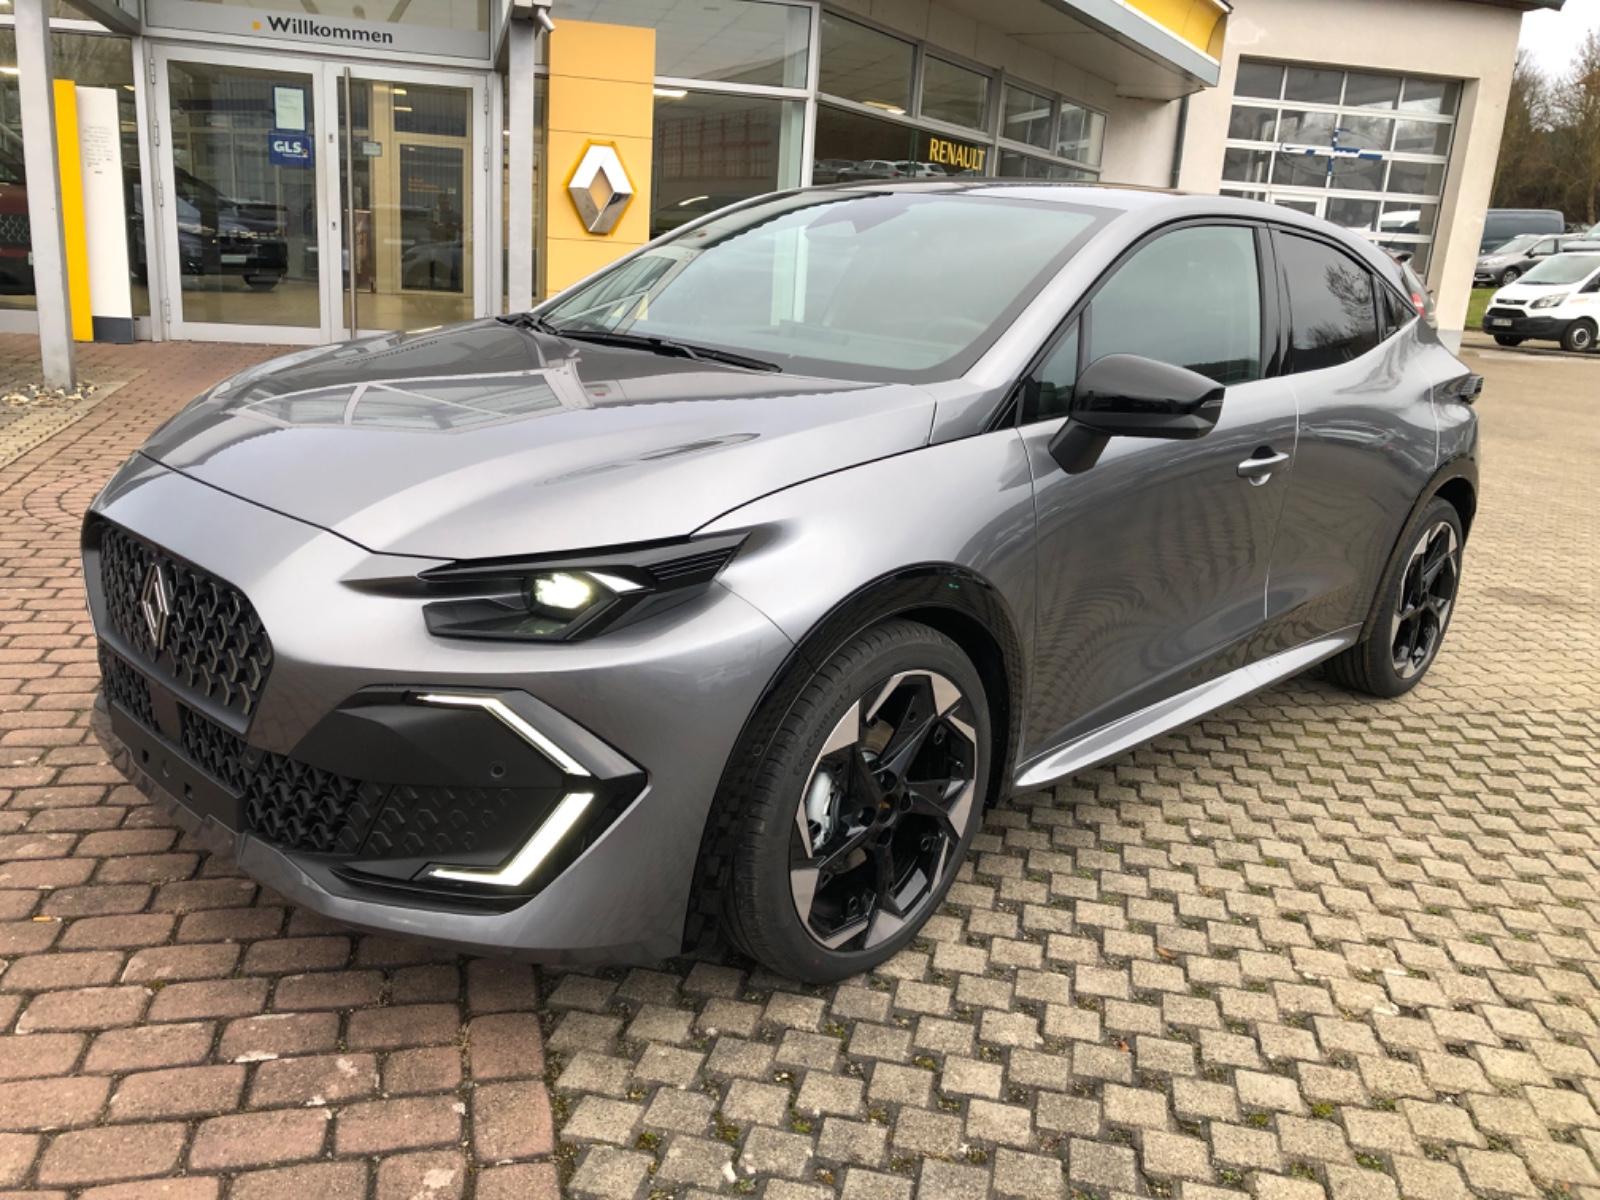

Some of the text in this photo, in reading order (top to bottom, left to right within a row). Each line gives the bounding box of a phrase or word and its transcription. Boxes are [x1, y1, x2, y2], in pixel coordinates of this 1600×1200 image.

[267, 16, 393, 44] Willkommen
[273, 140, 302, 153] GLS
[928, 138, 986, 171] RENAULT
